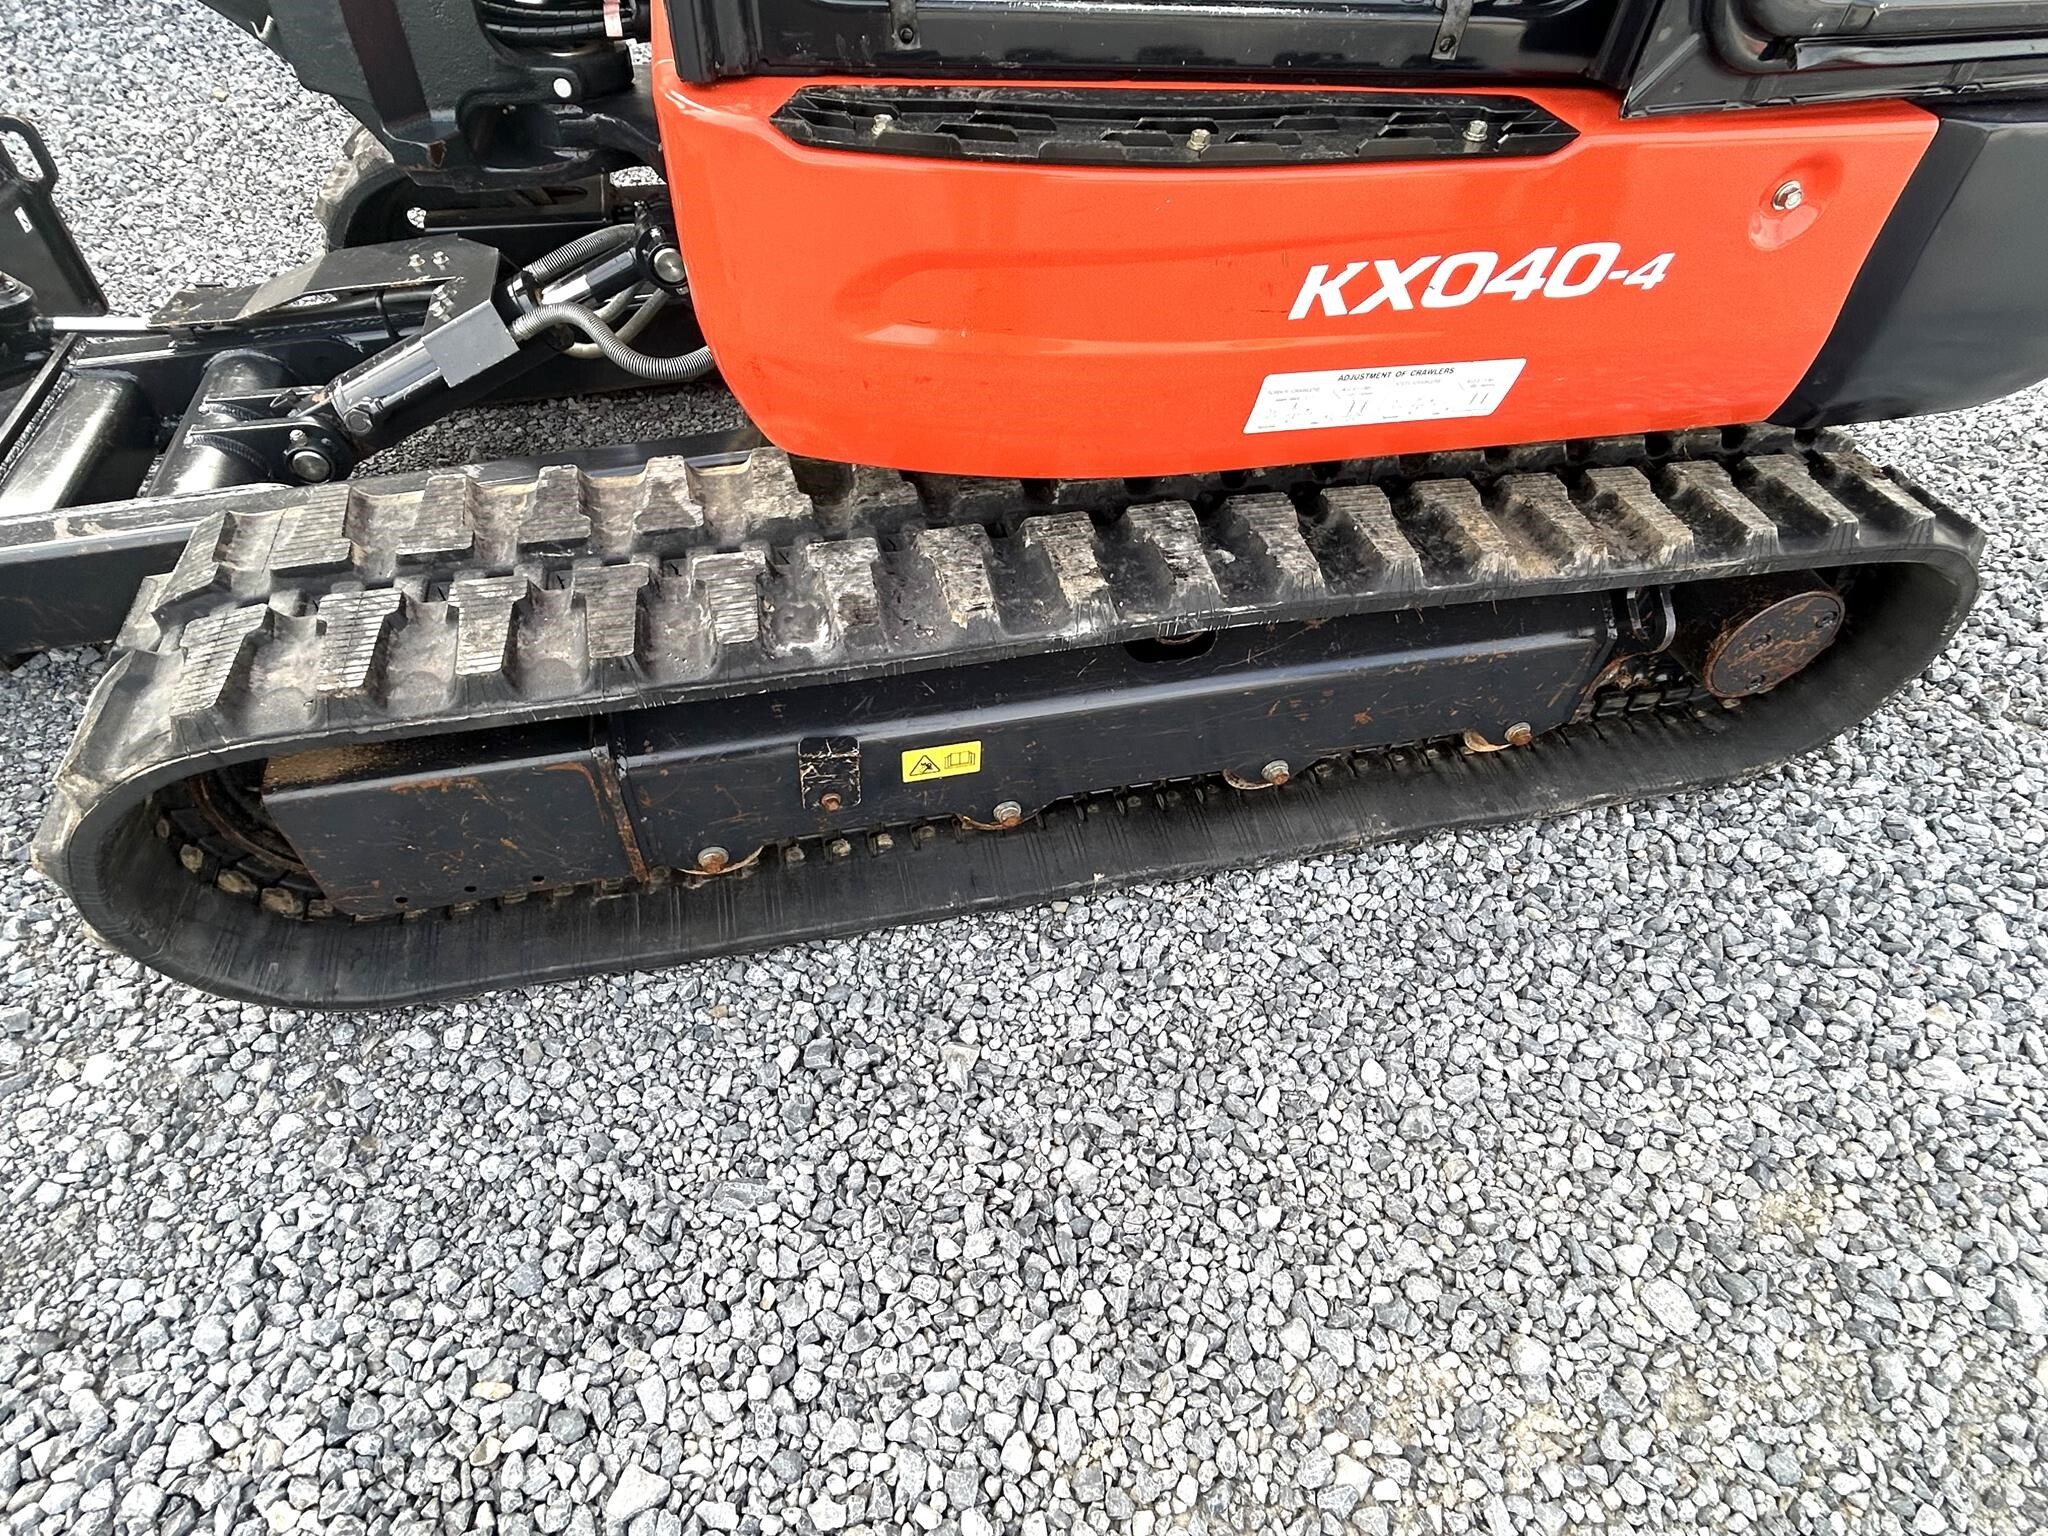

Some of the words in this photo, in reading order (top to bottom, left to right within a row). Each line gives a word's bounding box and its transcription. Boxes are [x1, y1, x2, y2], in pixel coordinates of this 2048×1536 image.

[1287, 242, 1676, 320] KX040-4
[1338, 371, 1392, 382] ADJUSTMENT
[1395, 370, 1407, 378] OF
[1410, 367, 1455, 377] CRAWLERS
